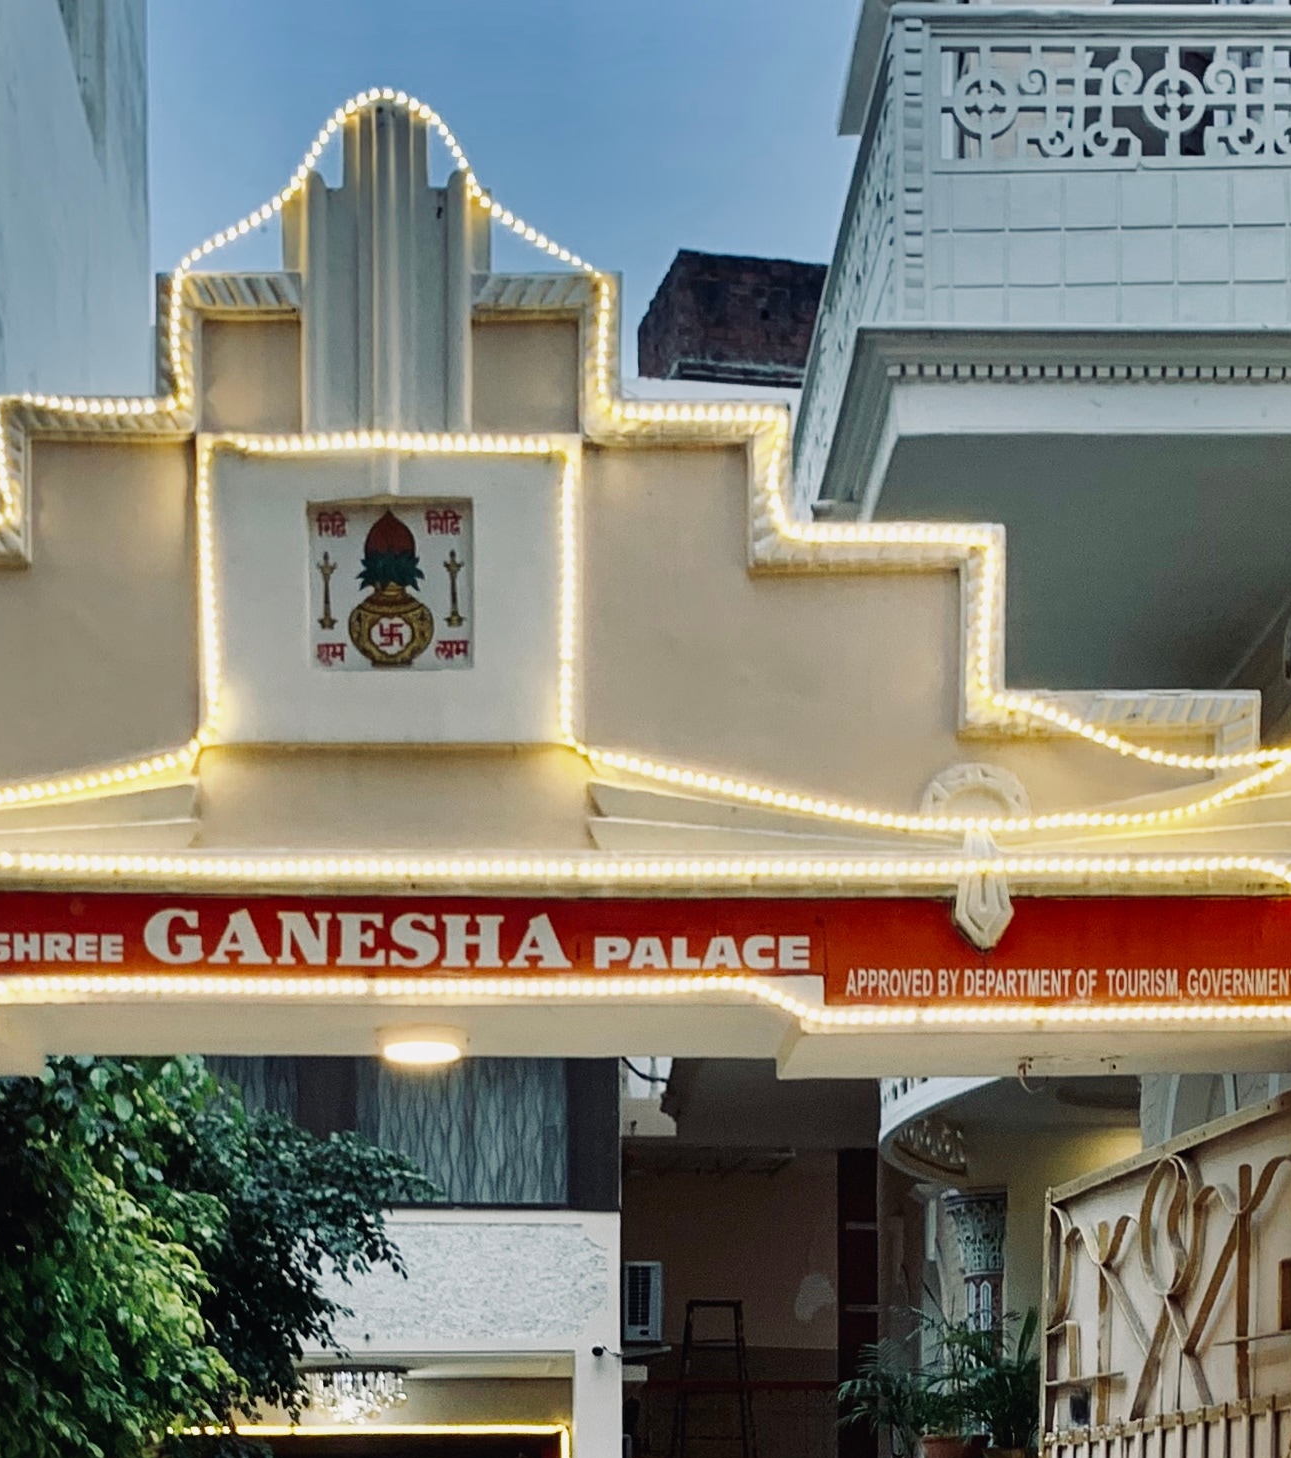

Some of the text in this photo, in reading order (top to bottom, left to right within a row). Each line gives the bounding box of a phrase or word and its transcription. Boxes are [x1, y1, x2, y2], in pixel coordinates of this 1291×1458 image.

[144, 910, 571, 968] GANESHA
[595, 936, 809, 969] PALACE
[846, 970, 933, 997] APPROVED
[938, 970, 958, 996] BY
[964, 970, 1071, 996] DEPARTMENT
[1076, 970, 1097, 998] OF
[1106, 970, 1182, 1000] TOURISM,
